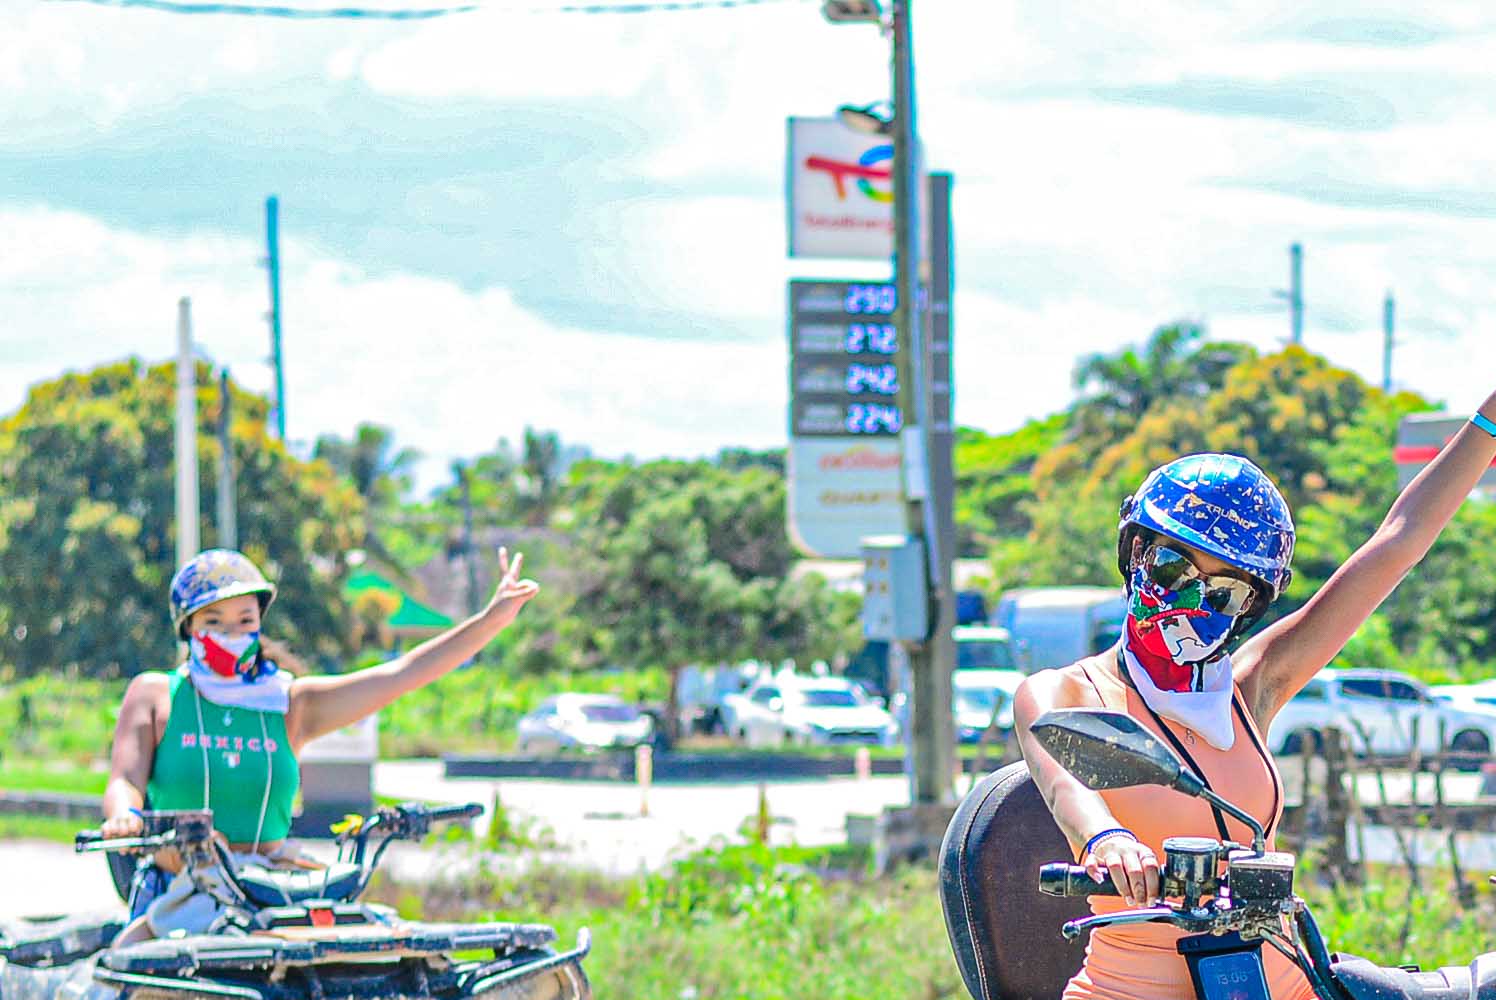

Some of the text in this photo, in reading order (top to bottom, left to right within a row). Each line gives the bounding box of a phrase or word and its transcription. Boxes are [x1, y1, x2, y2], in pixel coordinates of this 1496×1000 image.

[848, 363, 899, 392] 242
[848, 404, 902, 432] 224
[182, 733, 279, 753] MEXICO
